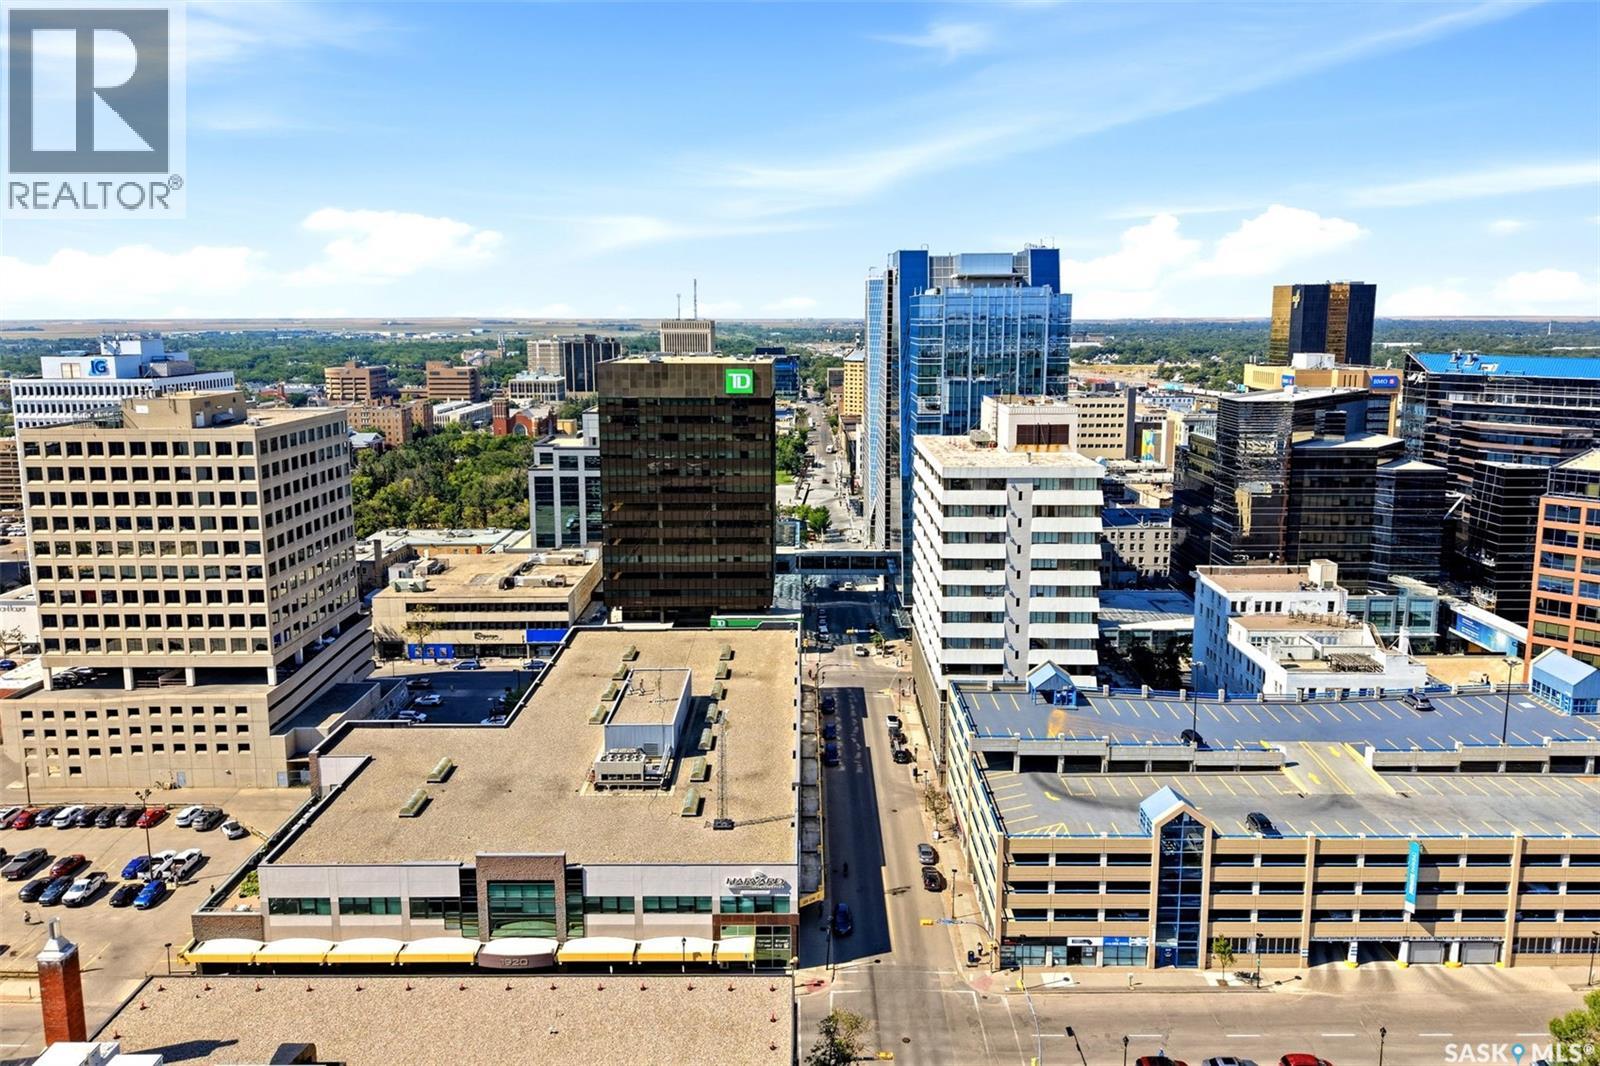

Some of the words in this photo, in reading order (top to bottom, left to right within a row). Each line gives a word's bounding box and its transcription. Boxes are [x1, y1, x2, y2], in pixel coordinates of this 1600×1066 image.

[90, 360, 107, 374] IG
[727, 373, 751, 389] TD
[726, 877, 785, 887] HARVARD
[500, 958, 529, 966] 1920
